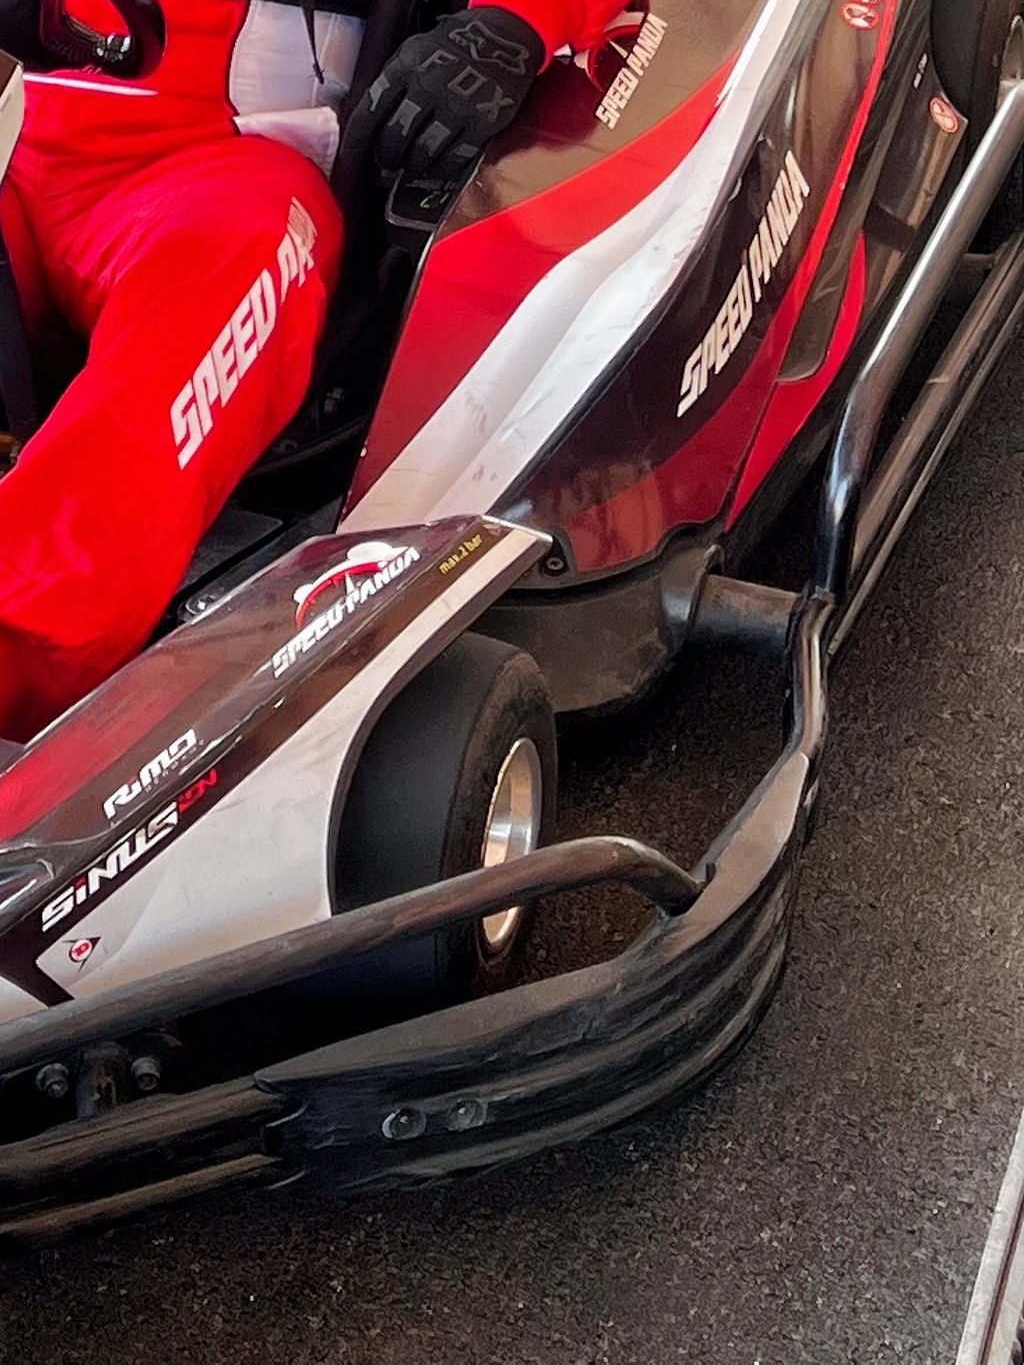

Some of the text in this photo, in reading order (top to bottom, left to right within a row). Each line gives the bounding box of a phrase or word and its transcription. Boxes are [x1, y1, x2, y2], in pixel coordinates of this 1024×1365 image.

[595, 12, 669, 131] SPEED PANDA
[677, 149, 810, 418] SPEED PANDA
[170, 267, 277, 471] SPEED
[271, 546, 421, 679] SPEED PANDA
